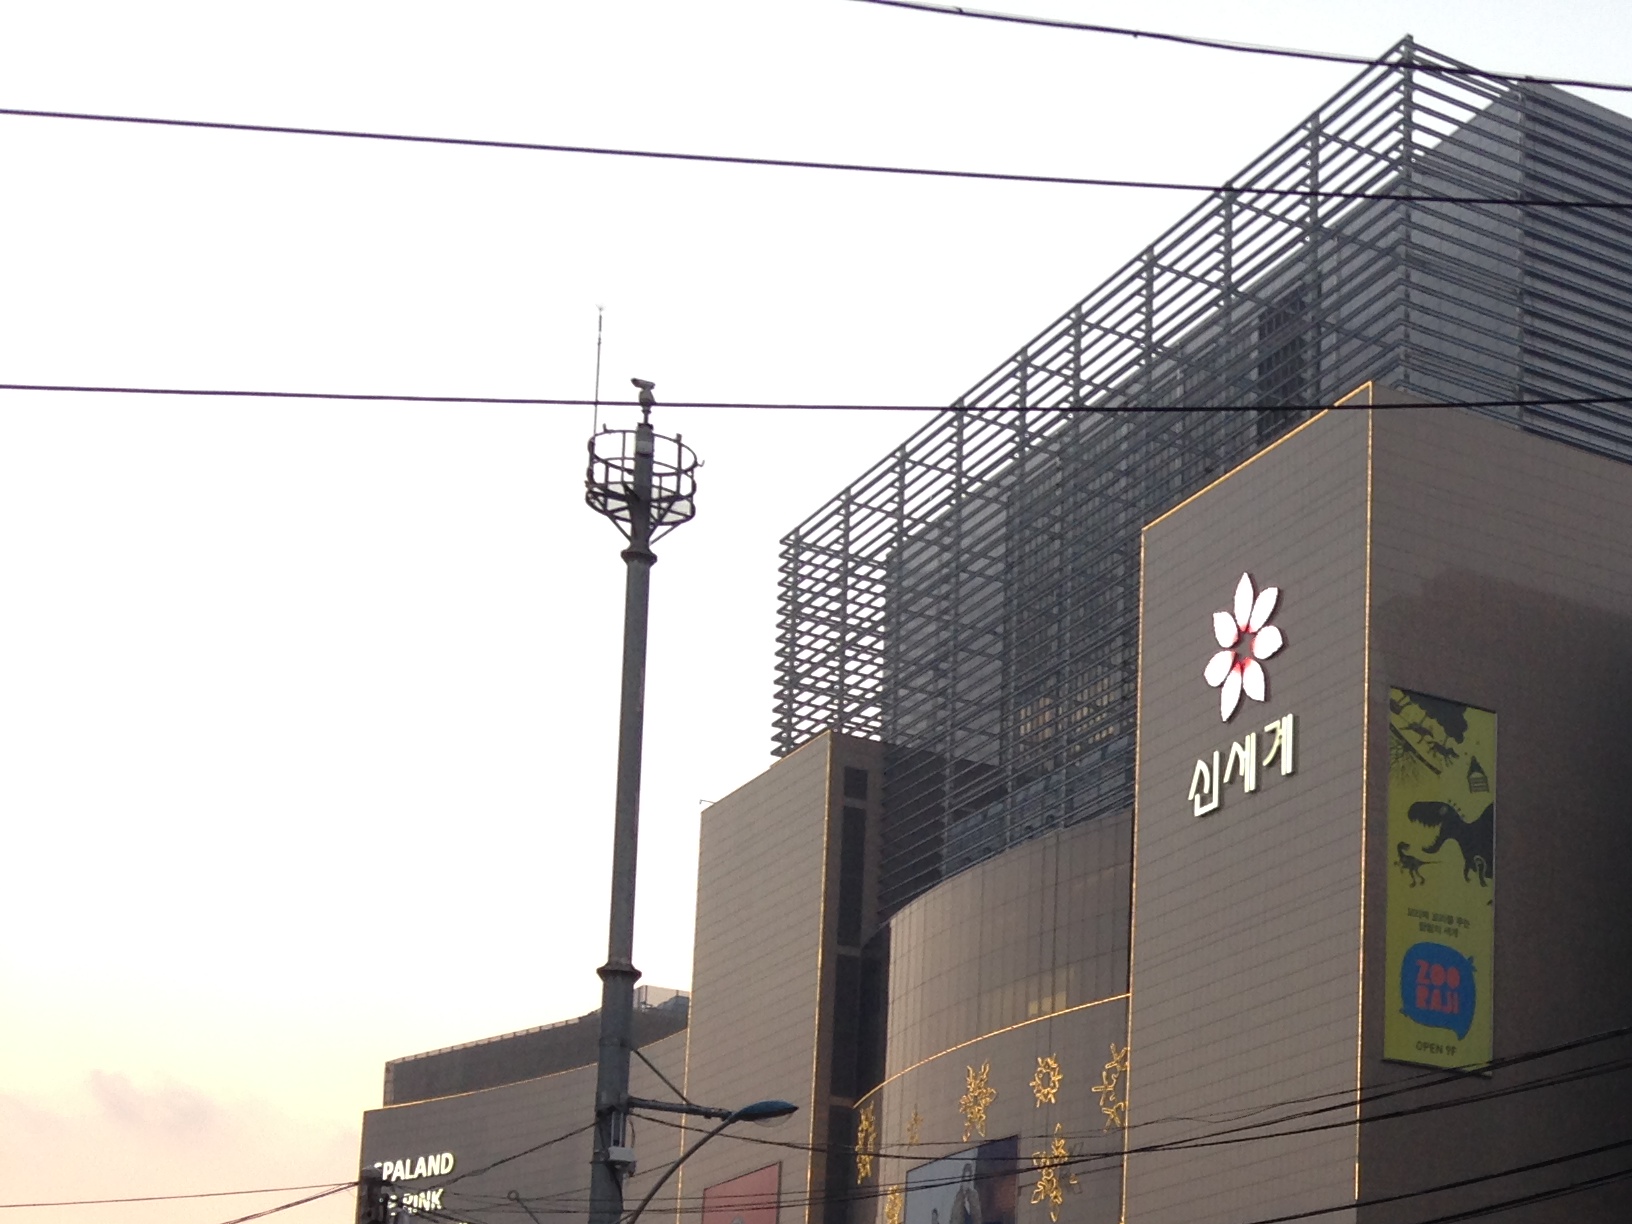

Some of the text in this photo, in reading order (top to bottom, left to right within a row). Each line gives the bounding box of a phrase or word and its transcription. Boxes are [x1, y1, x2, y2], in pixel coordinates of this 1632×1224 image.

[1188, 713, 1293, 817] 신세계
[1416, 960, 1461, 989] ZOO
[1415, 1040, 1443, 1055] OPEN
[374, 1152, 454, 1182] PALAND
